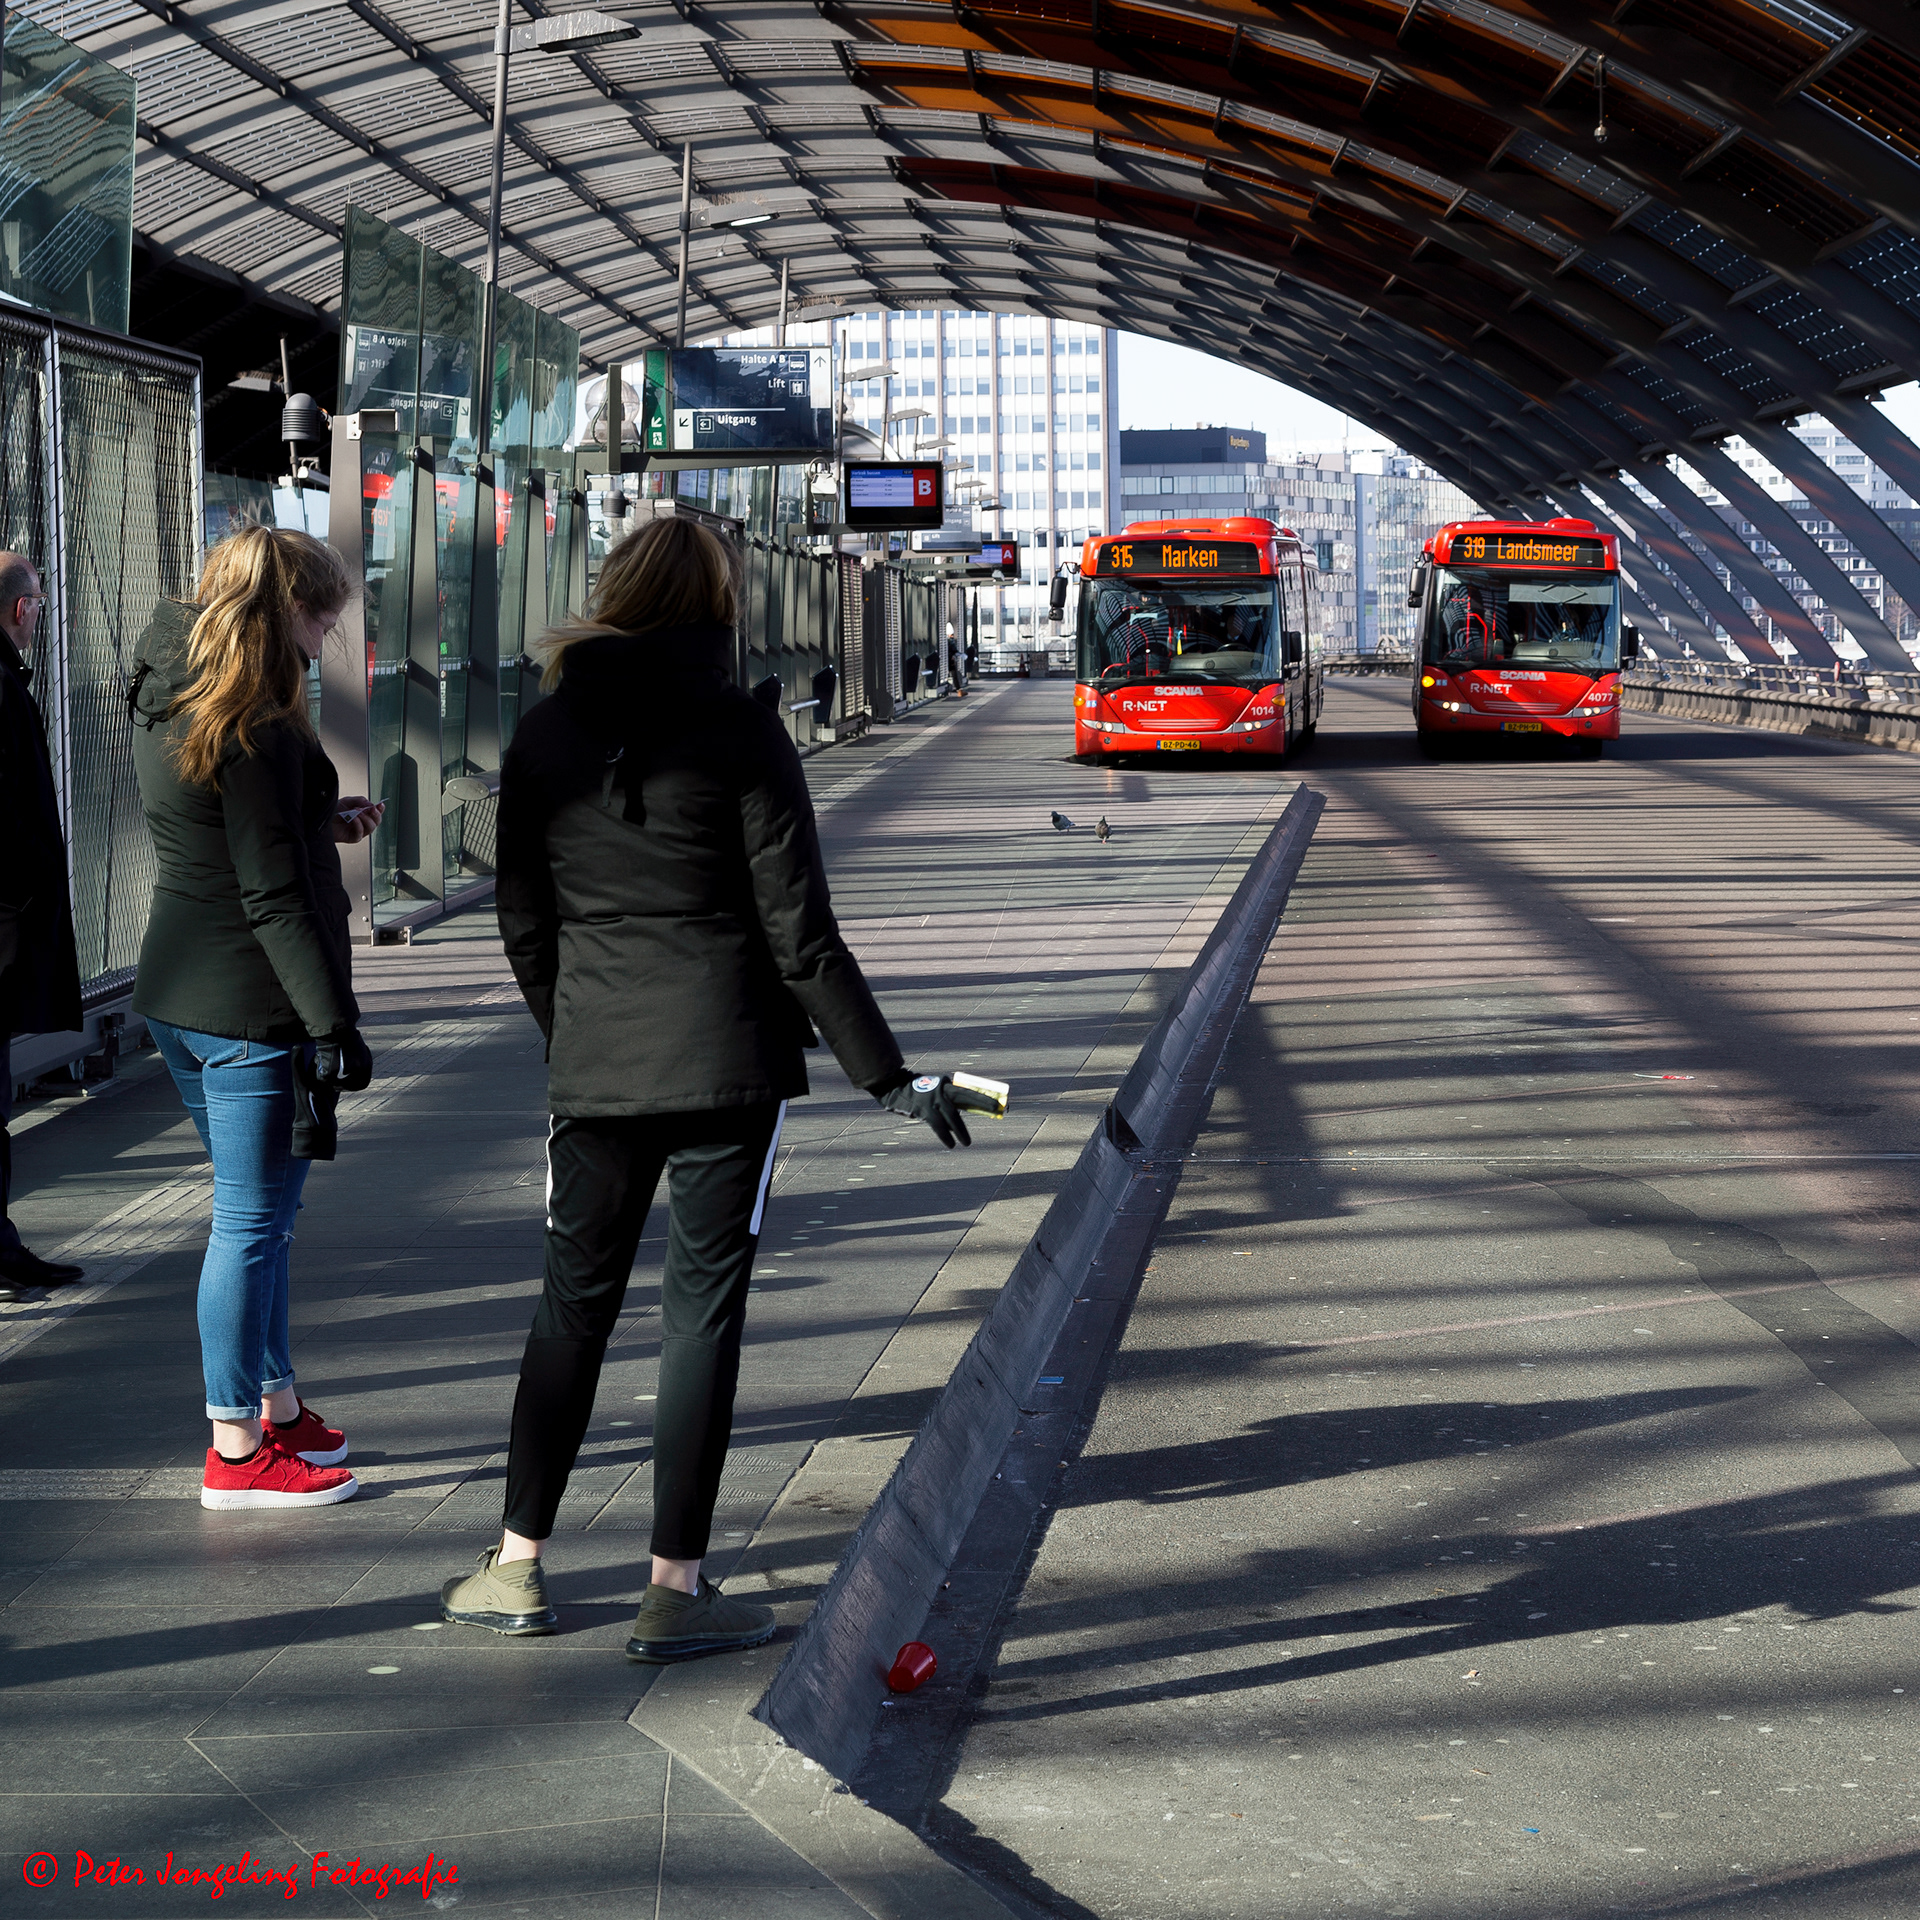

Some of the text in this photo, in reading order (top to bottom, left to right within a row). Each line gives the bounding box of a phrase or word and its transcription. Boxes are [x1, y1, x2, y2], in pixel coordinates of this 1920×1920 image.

[740, 354, 786, 364] Halte A B
[768, 377, 786, 389] Lift
[717, 414, 757, 426] Uitgang
[918, 479, 932, 496] B
[1003, 549, 1012, 559] A
[1463, 536, 1579, 562] 319 Landsmeer
[1111, 544, 1218, 568] 315 Marken
[1499, 671, 1547, 682] SCANIA
[1154, 686, 1204, 696] SCANIA
[1588, 692, 1614, 702] 4077
[1250, 705, 1275, 716] 1014
